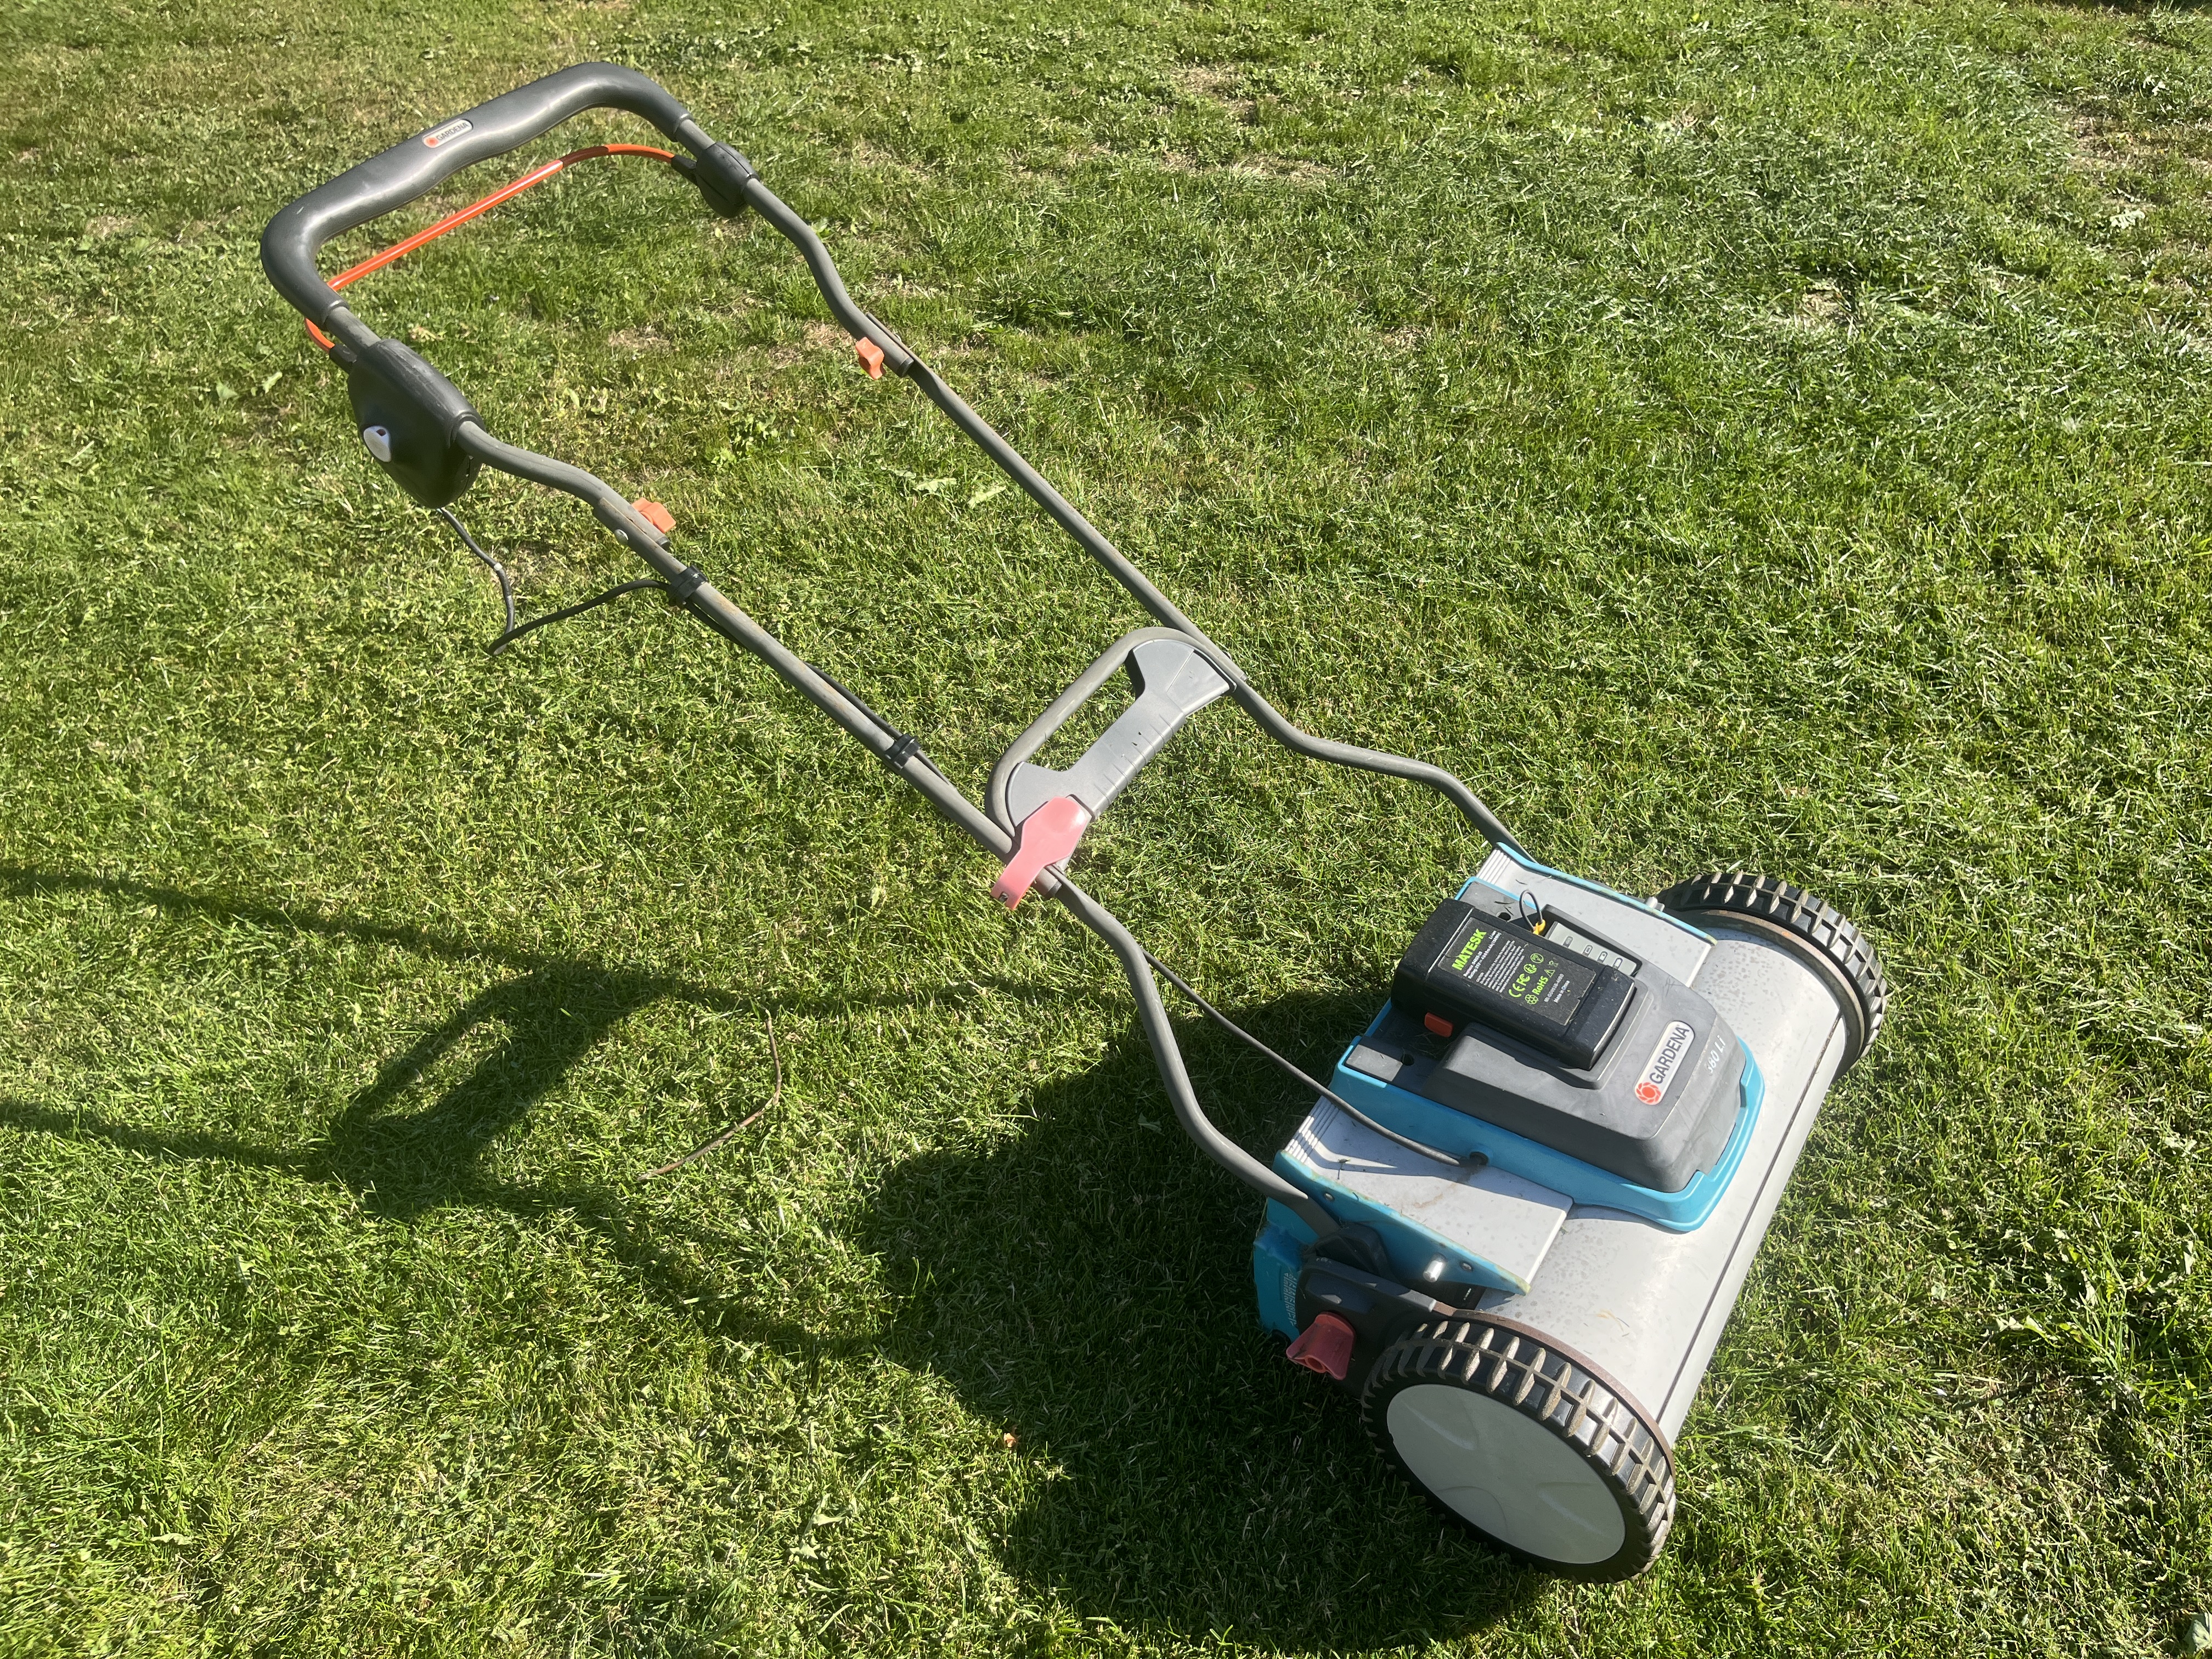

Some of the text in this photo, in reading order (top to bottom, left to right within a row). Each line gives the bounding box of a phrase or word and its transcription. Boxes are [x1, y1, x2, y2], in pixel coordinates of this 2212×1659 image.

[436, 122, 469, 140] GARDENA
[1452, 928, 1487, 970] MATESK
[1509, 983, 1526, 997] CE
[1532, 975, 1548, 995] RoHS
[1714, 1035, 1726, 1053] Li
[1649, 1026, 1690, 1084] GARDENA
